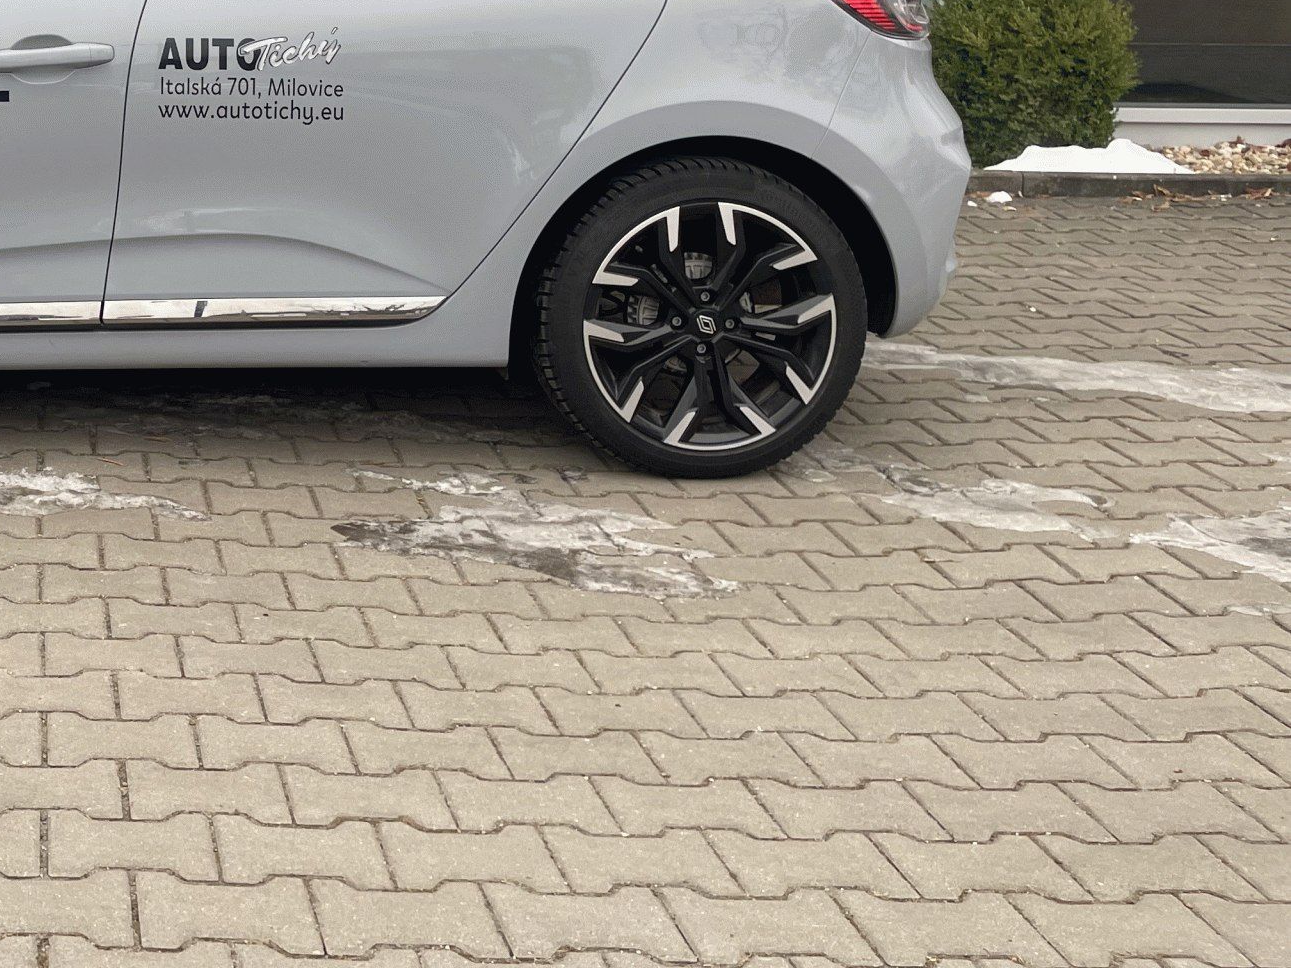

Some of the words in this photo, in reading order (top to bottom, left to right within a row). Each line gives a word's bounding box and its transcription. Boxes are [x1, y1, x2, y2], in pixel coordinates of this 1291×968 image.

[158, 37, 261, 71] AUTO
[238, 26, 341, 71] Tichý
[160, 77, 222, 95] Italská
[227, 77, 262, 99] 701,
[268, 78, 344, 97] Milovice
[158, 100, 345, 125] www.autotichy.eu
